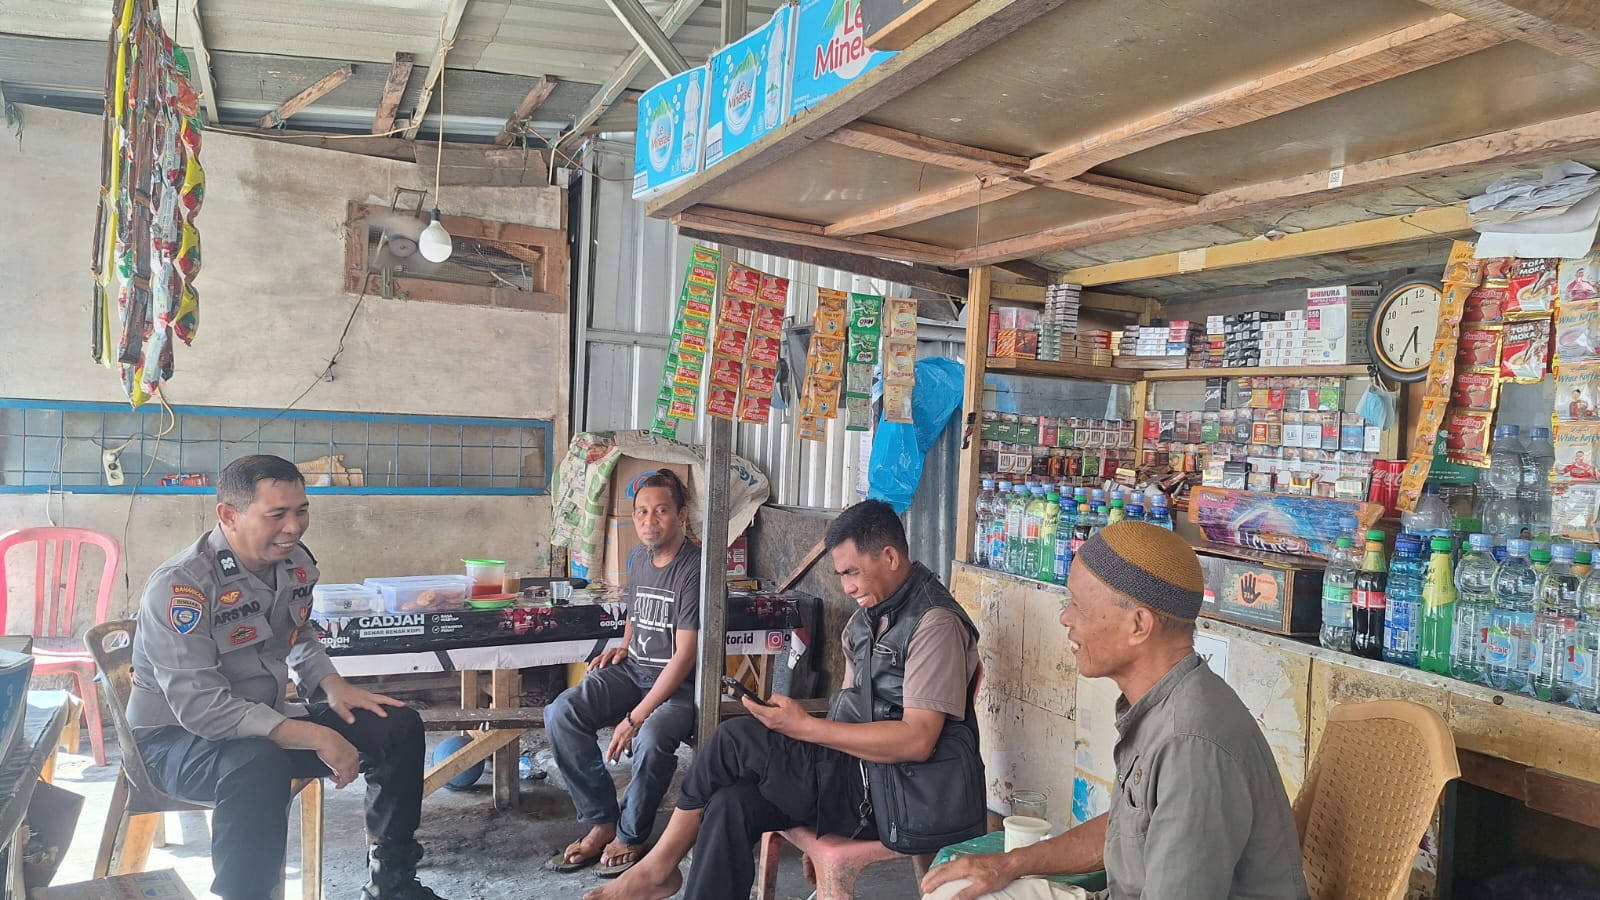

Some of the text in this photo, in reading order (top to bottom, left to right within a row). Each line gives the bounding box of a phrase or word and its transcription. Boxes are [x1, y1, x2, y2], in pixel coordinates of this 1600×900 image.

[844, 0, 863, 35] Le
[815, 37, 876, 78] Miner
[1520, 266, 1546, 276] MOKA
[1310, 289, 1340, 298] SHIMURA
[1416, 289, 1424, 299] 12
[1433, 293, 1437, 302] 1
[1400, 297, 1408, 306] 11
[1388, 310, 1396, 320] 10
[1386, 328, 1390, 336] 9
[1510, 332, 1536, 341] MOKA
[1390, 344, 1394, 352] 8
[1415, 358, 1420, 366] 6
[214, 600, 260, 626] ARSYAD
[359, 614, 424, 628] GADJAH
[727, 632, 754, 644] tor.id
